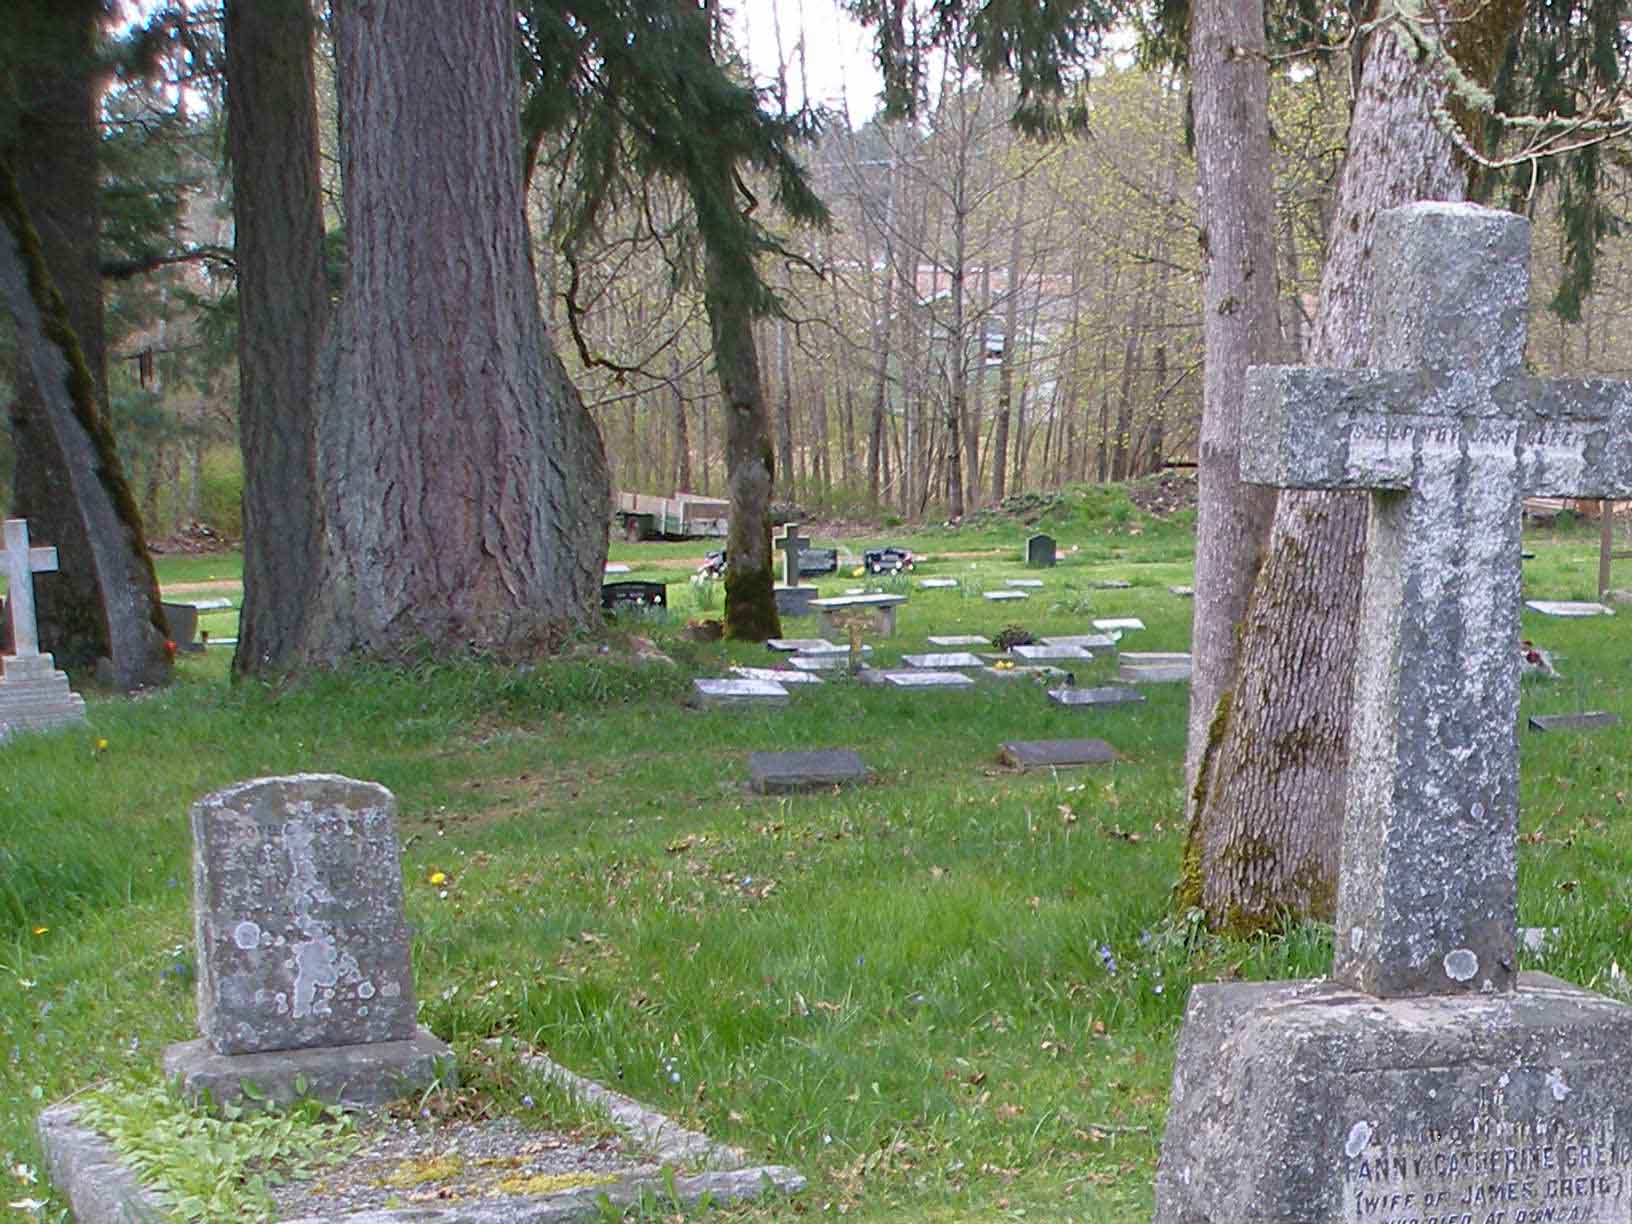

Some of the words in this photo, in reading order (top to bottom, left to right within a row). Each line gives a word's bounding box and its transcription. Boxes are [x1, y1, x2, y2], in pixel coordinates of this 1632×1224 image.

[1345, 1154, 1424, 1182] FANNY
[1434, 1146, 1554, 1177] CATHERINE
[1461, 1179, 1538, 1205] JAMES
